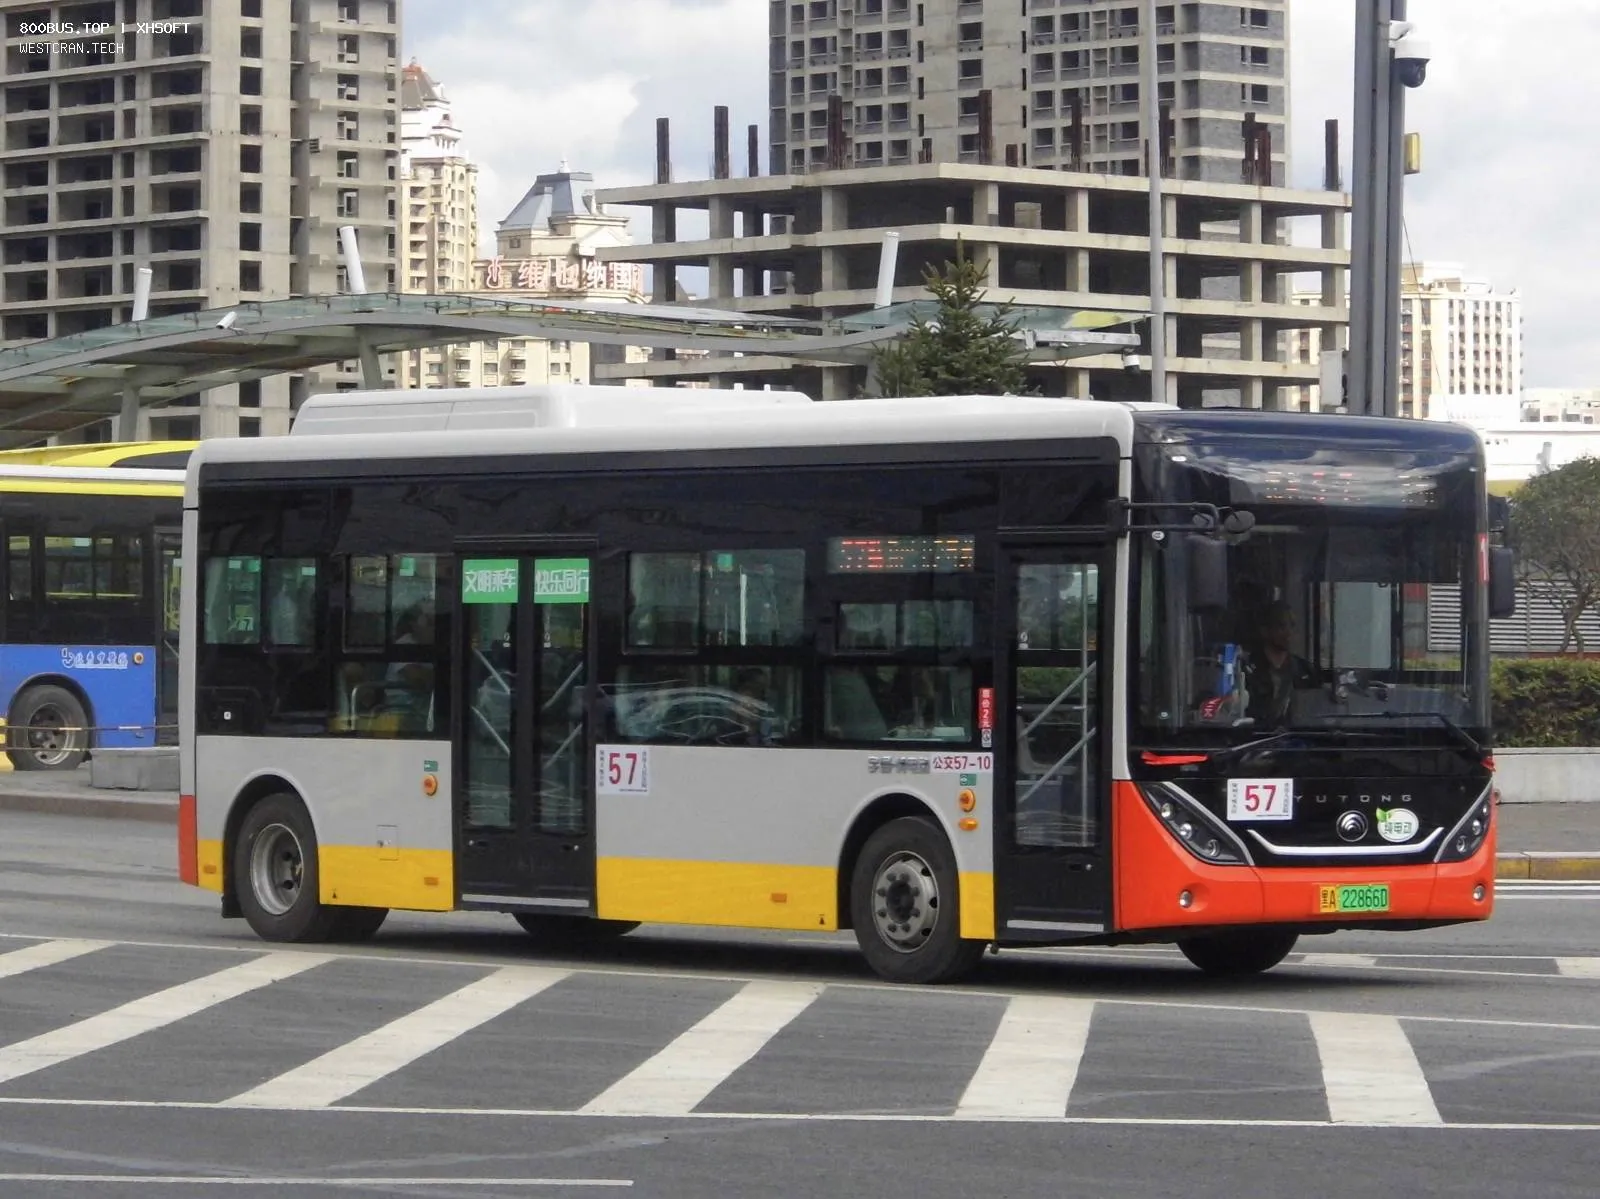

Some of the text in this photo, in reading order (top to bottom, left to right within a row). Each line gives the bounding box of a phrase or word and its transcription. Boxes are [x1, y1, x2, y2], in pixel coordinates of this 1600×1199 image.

[464, 567, 517, 593] 文明乘车
[535, 568, 590, 595] 快乐同行
[608, 752, 638, 785] 57
[932, 755, 991, 770] 公交57-10
[1245, 784, 1277, 812] 57
[1294, 794, 1413, 804] YUTONG
